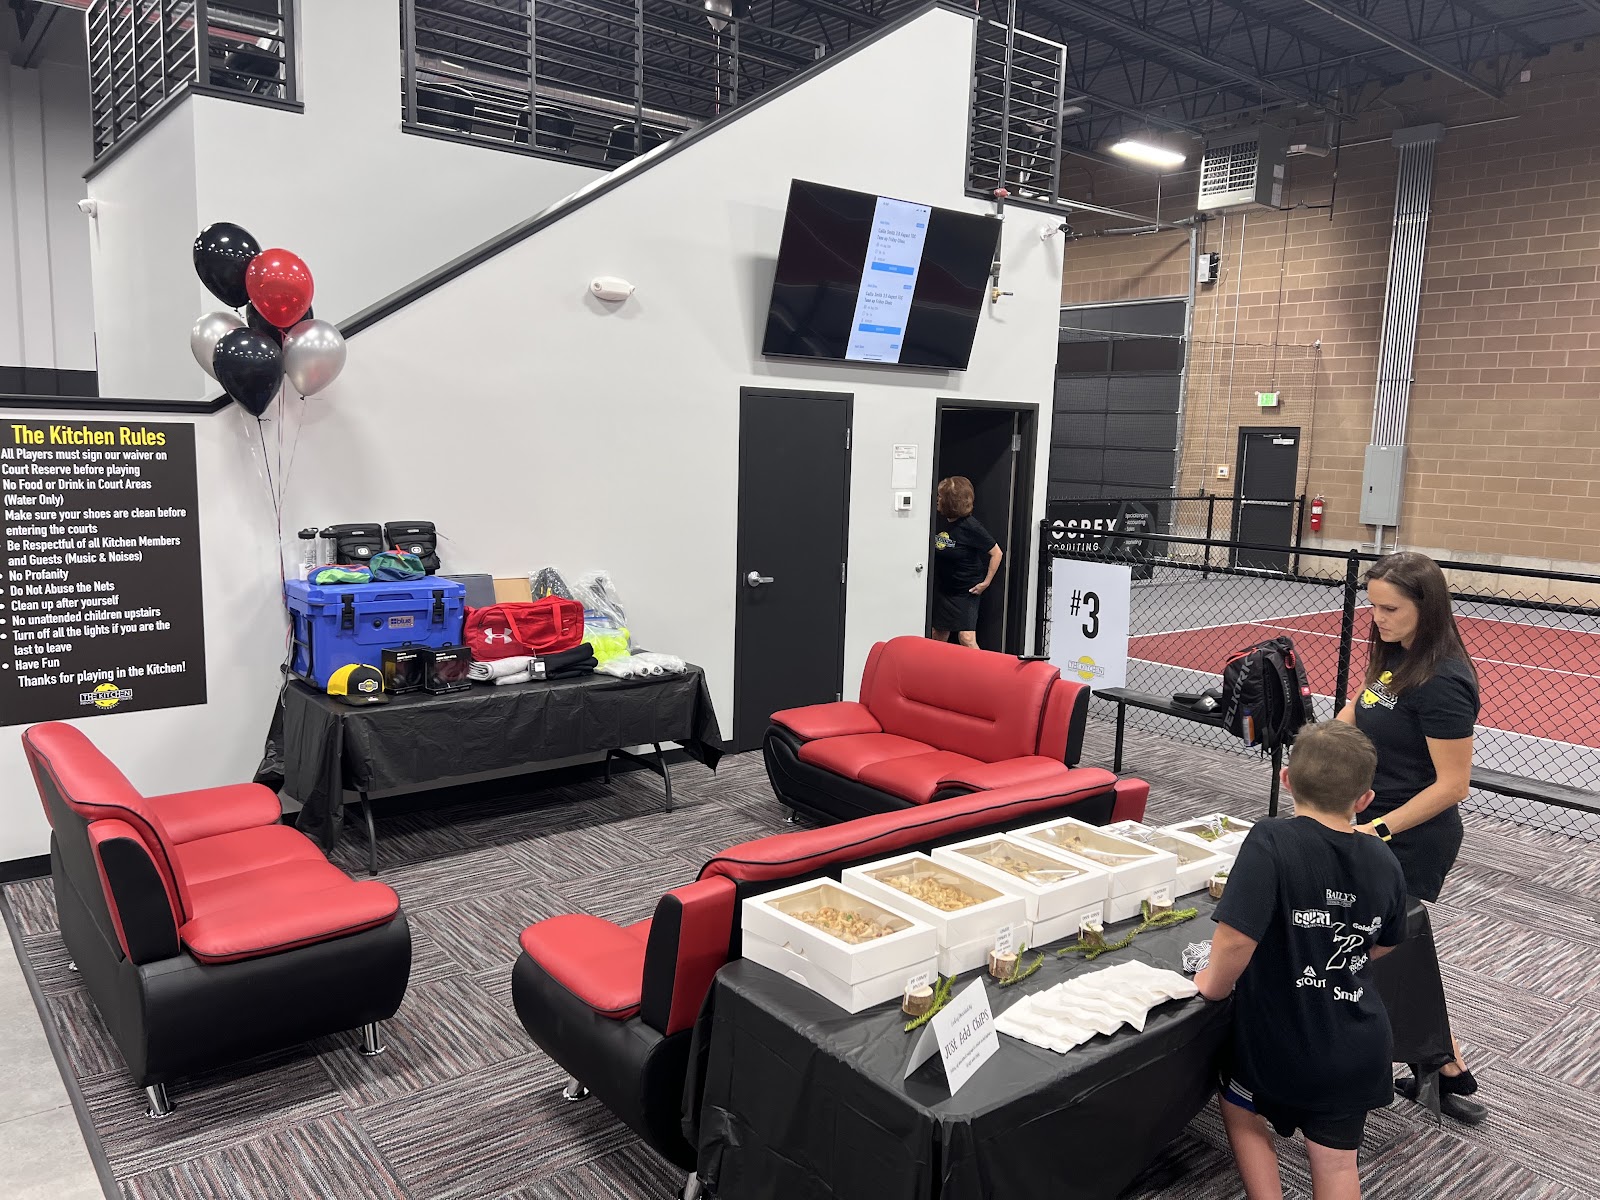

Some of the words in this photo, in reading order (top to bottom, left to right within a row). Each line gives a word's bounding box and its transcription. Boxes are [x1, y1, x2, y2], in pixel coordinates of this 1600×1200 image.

[11, 425, 44, 444] The
[50, 425, 114, 445] Kitchen
[120, 427, 165, 446] Rules
[1, 448, 14, 459] All
[16, 448, 53, 462] Players
[56, 450, 80, 460] must
[82, 449, 102, 462] sign
[105, 452, 121, 460] our
[122, 449, 154, 460] waiver
[156, 452, 167, 460] on
[2, 464, 29, 475] Court
[31, 464, 71, 475] Reserve
[73, 464, 104, 475] before
[107, 464, 140, 477] playing
[3, 479, 16, 490] No
[19, 479, 43, 490] Food
[45, 481, 56, 490] or
[58, 479, 84, 490] Drink
[87, 479, 96, 489] in
[98, 479, 124, 489] Court
[125, 479, 152, 489] Areas
[4, 494, 37, 506] (Water
[39, 494, 64, 507] Only)
[5, 509, 32, 521] Make
[35, 512, 57, 520] sure
[59, 511, 81, 522] your
[83, 508, 111, 519] shoes
[113, 510, 129, 518] are
[131, 508, 155, 518] clean
[158, 507, 186, 517] before
[6, 524, 47, 538] entering
[49, 524, 65, 535] the
[68, 524, 98, 534] courts
[7, 540, 20, 551] Be
[23, 538, 75, 552] Respectful
[77, 538, 86, 549] of
[88, 537, 100, 548] all
[102, 537, 136, 548] Kitchen
[139, 536, 180, 546] Members
[8, 555, 27, 566] and
[29, 554, 62, 565] Guests
[65, 552, 97, 565] (Music
[99, 553, 106, 562] &
[109, 551, 142, 563] Noises)
[9, 570, 22, 581] No
[25, 568, 69, 581] Profanity
[10, 585, 23, 596] Do
[26, 584, 43, 595] Not
[45, 583, 74, 594] Abuse
[76, 582, 91, 592] the
[94, 581, 115, 592] Nets
[11, 600, 39, 611] Clean
[41, 601, 54, 612] up
[56, 598, 79, 608] after
[80, 594, 119, 610] yourself
[12, 615, 25, 626] No
[28, 611, 81, 625] unattended
[84, 610, 122, 621] children
[124, 607, 161, 621] upstairs
[1070, 589, 1100, 639] #3
[12, 630, 34, 641] Turn
[37, 628, 50, 639] off
[53, 627, 65, 638] all
[66, 626, 81, 637] the
[84, 625, 110, 638] lights
[112, 623, 119, 634] if
[120, 624, 137, 636] you
[139, 623, 154, 632] are
[156, 620, 170, 630] the
[14, 645, 33, 655] last
[34, 644, 44, 654] to
[46, 643, 72, 653] leave
[15, 660, 39, 670] Have
[42, 658, 60, 668] Fun
[18, 674, 57, 687] Thanks
[59, 672, 74, 683] for
[77, 669, 114, 684] playing
[116, 667, 126, 678] in
[128, 666, 144, 677] the
[147, 661, 186, 675] Kitchen!
[98, 690, 130, 700] KITCHEN
[1296, 977, 1326, 988] STOUT
